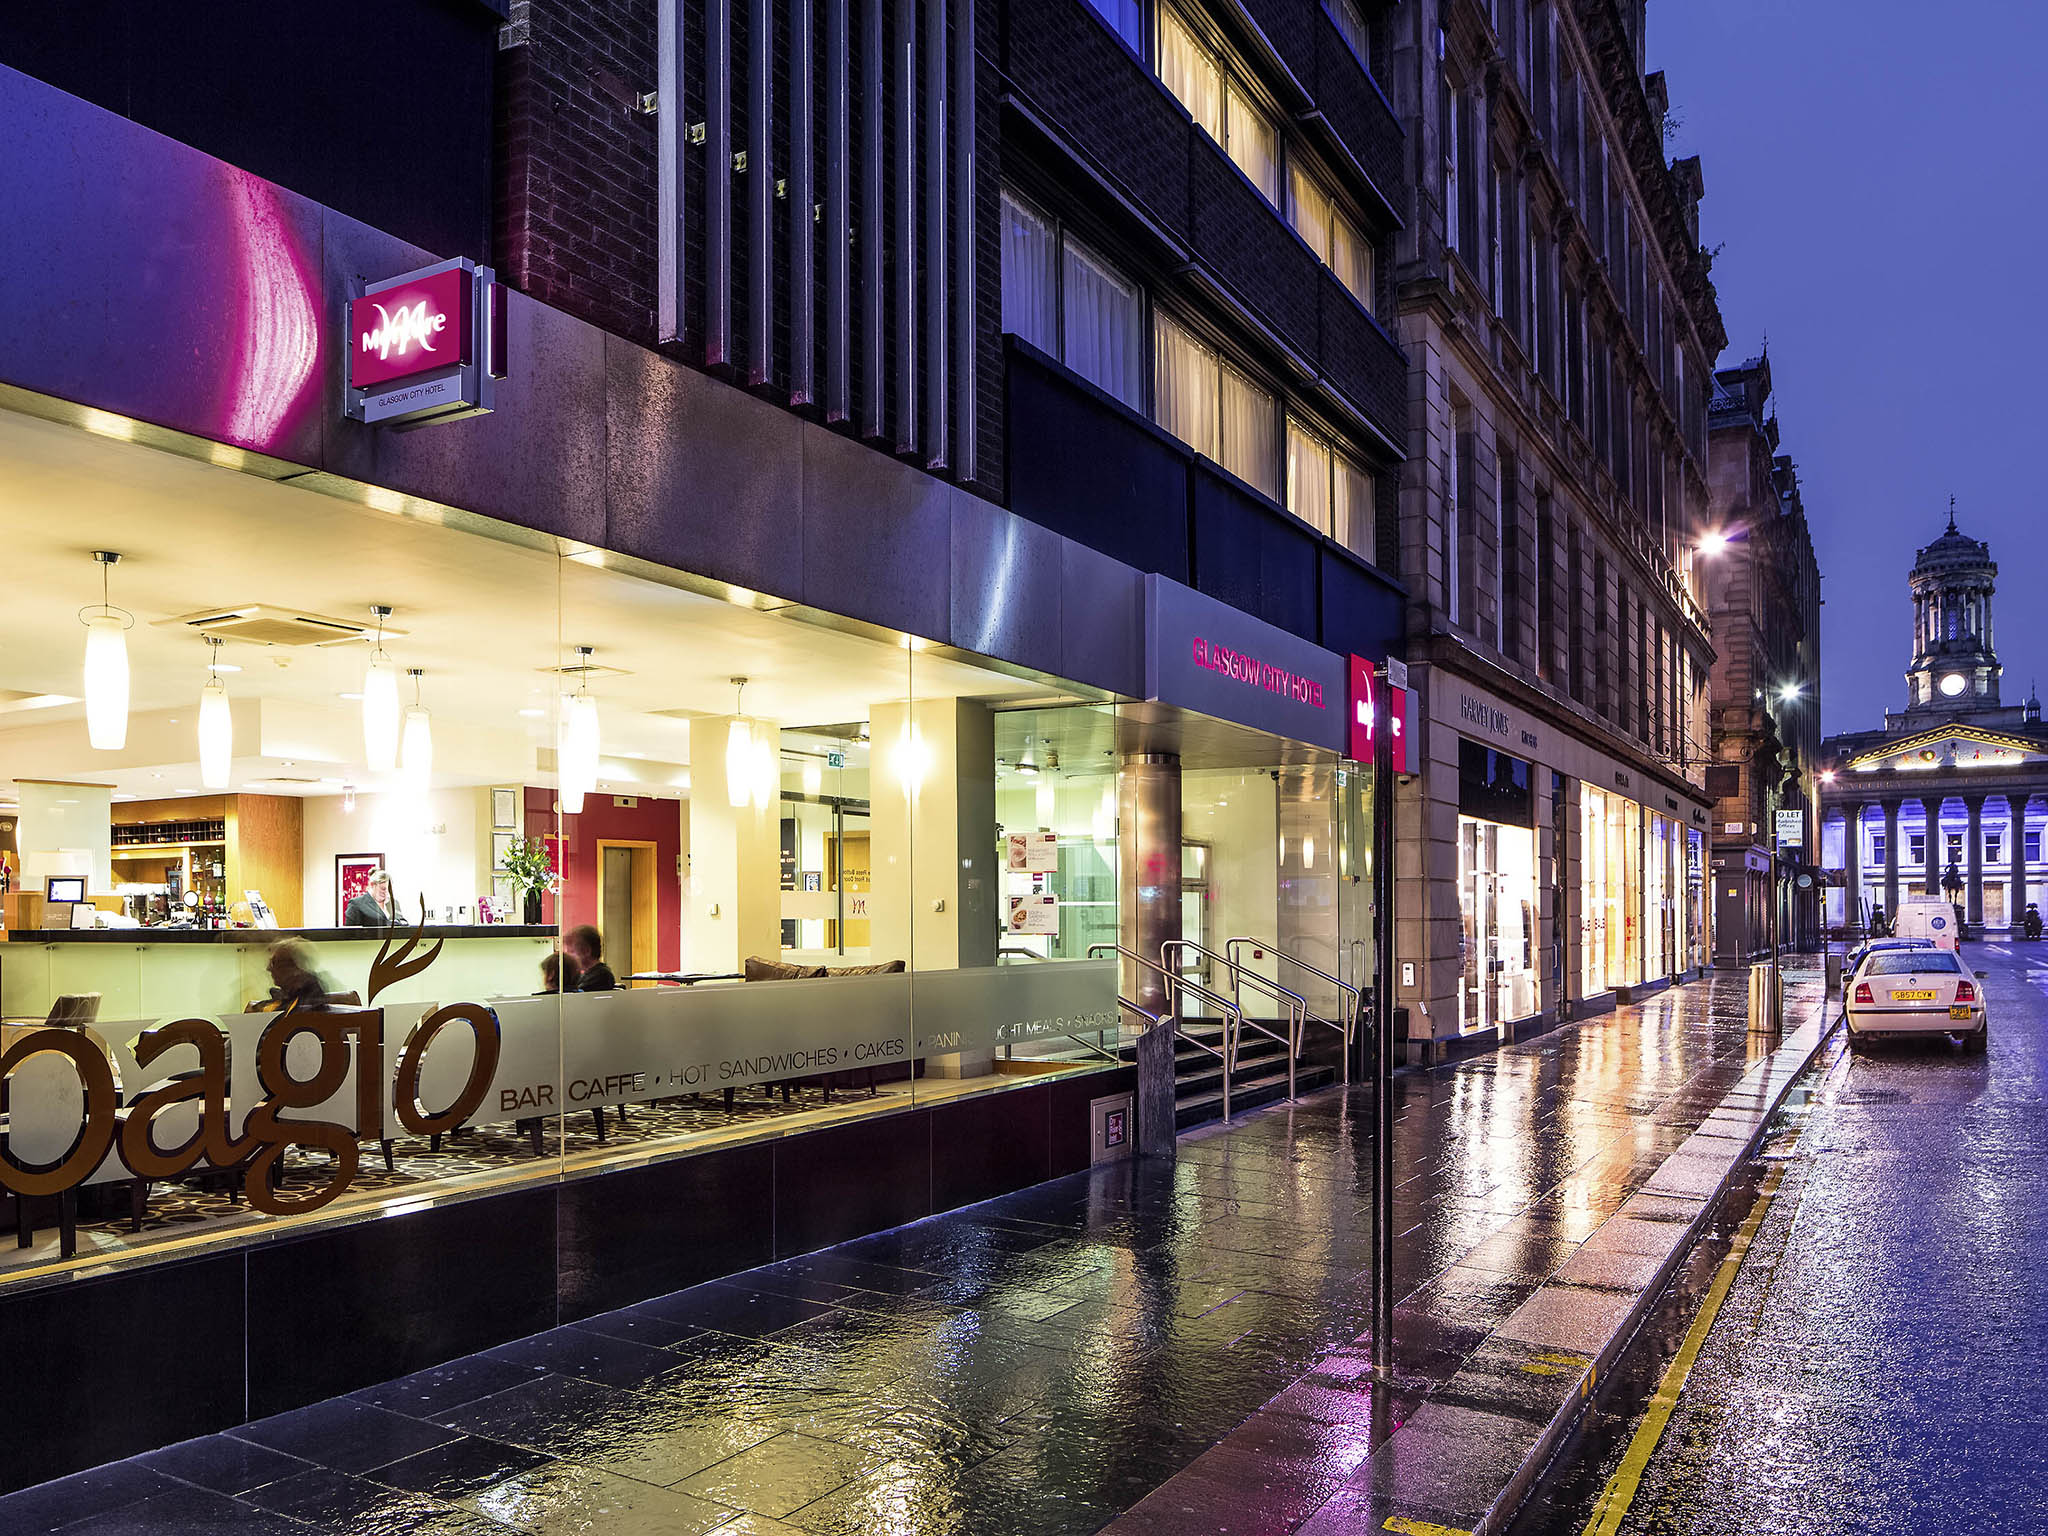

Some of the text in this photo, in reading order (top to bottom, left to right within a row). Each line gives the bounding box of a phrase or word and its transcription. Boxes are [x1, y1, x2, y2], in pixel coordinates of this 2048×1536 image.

[379, 384, 446, 407] GLASGOW CITY HOTEL
[1193, 637, 1260, 686] GLASGOW
[1262, 664, 1289, 697] CITY
[1291, 674, 1326, 710] HOTEL
[500, 1084, 553, 1112] BAR
[568, 1072, 646, 1100] CAFFE
[670, 1062, 710, 1086] HOT
[719, 1048, 838, 1080] SANDWICHES
[855, 1039, 904, 1060] CAKES
